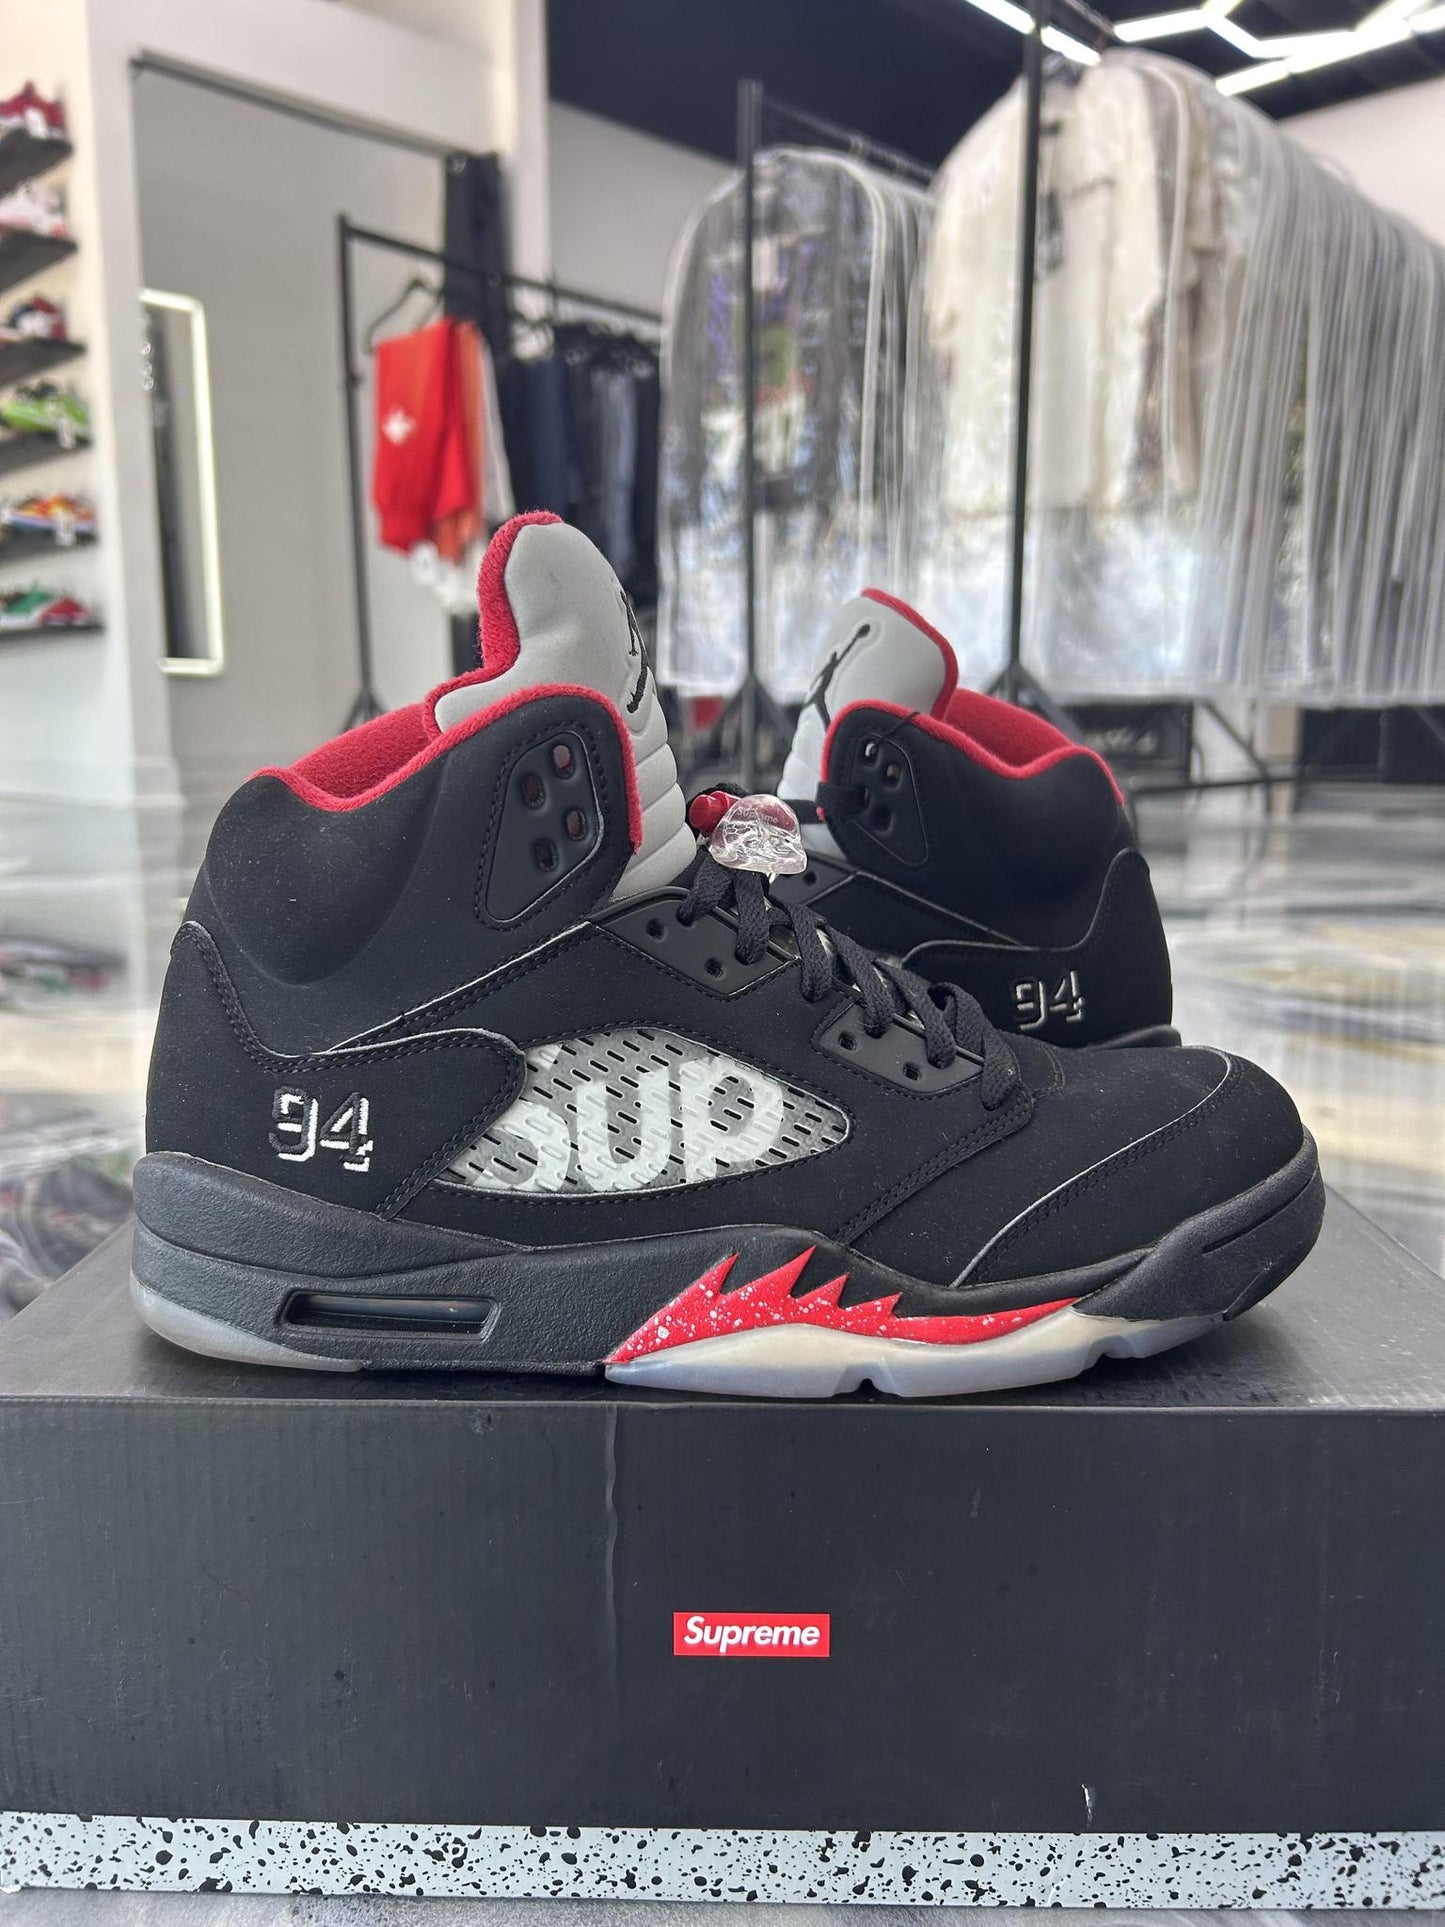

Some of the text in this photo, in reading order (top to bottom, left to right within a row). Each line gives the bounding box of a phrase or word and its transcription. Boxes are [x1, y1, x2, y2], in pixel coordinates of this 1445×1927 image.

[1011, 969, 1084, 1031] 94
[269, 1086, 374, 1172] 94
[683, 1615, 821, 1654] Supreme
